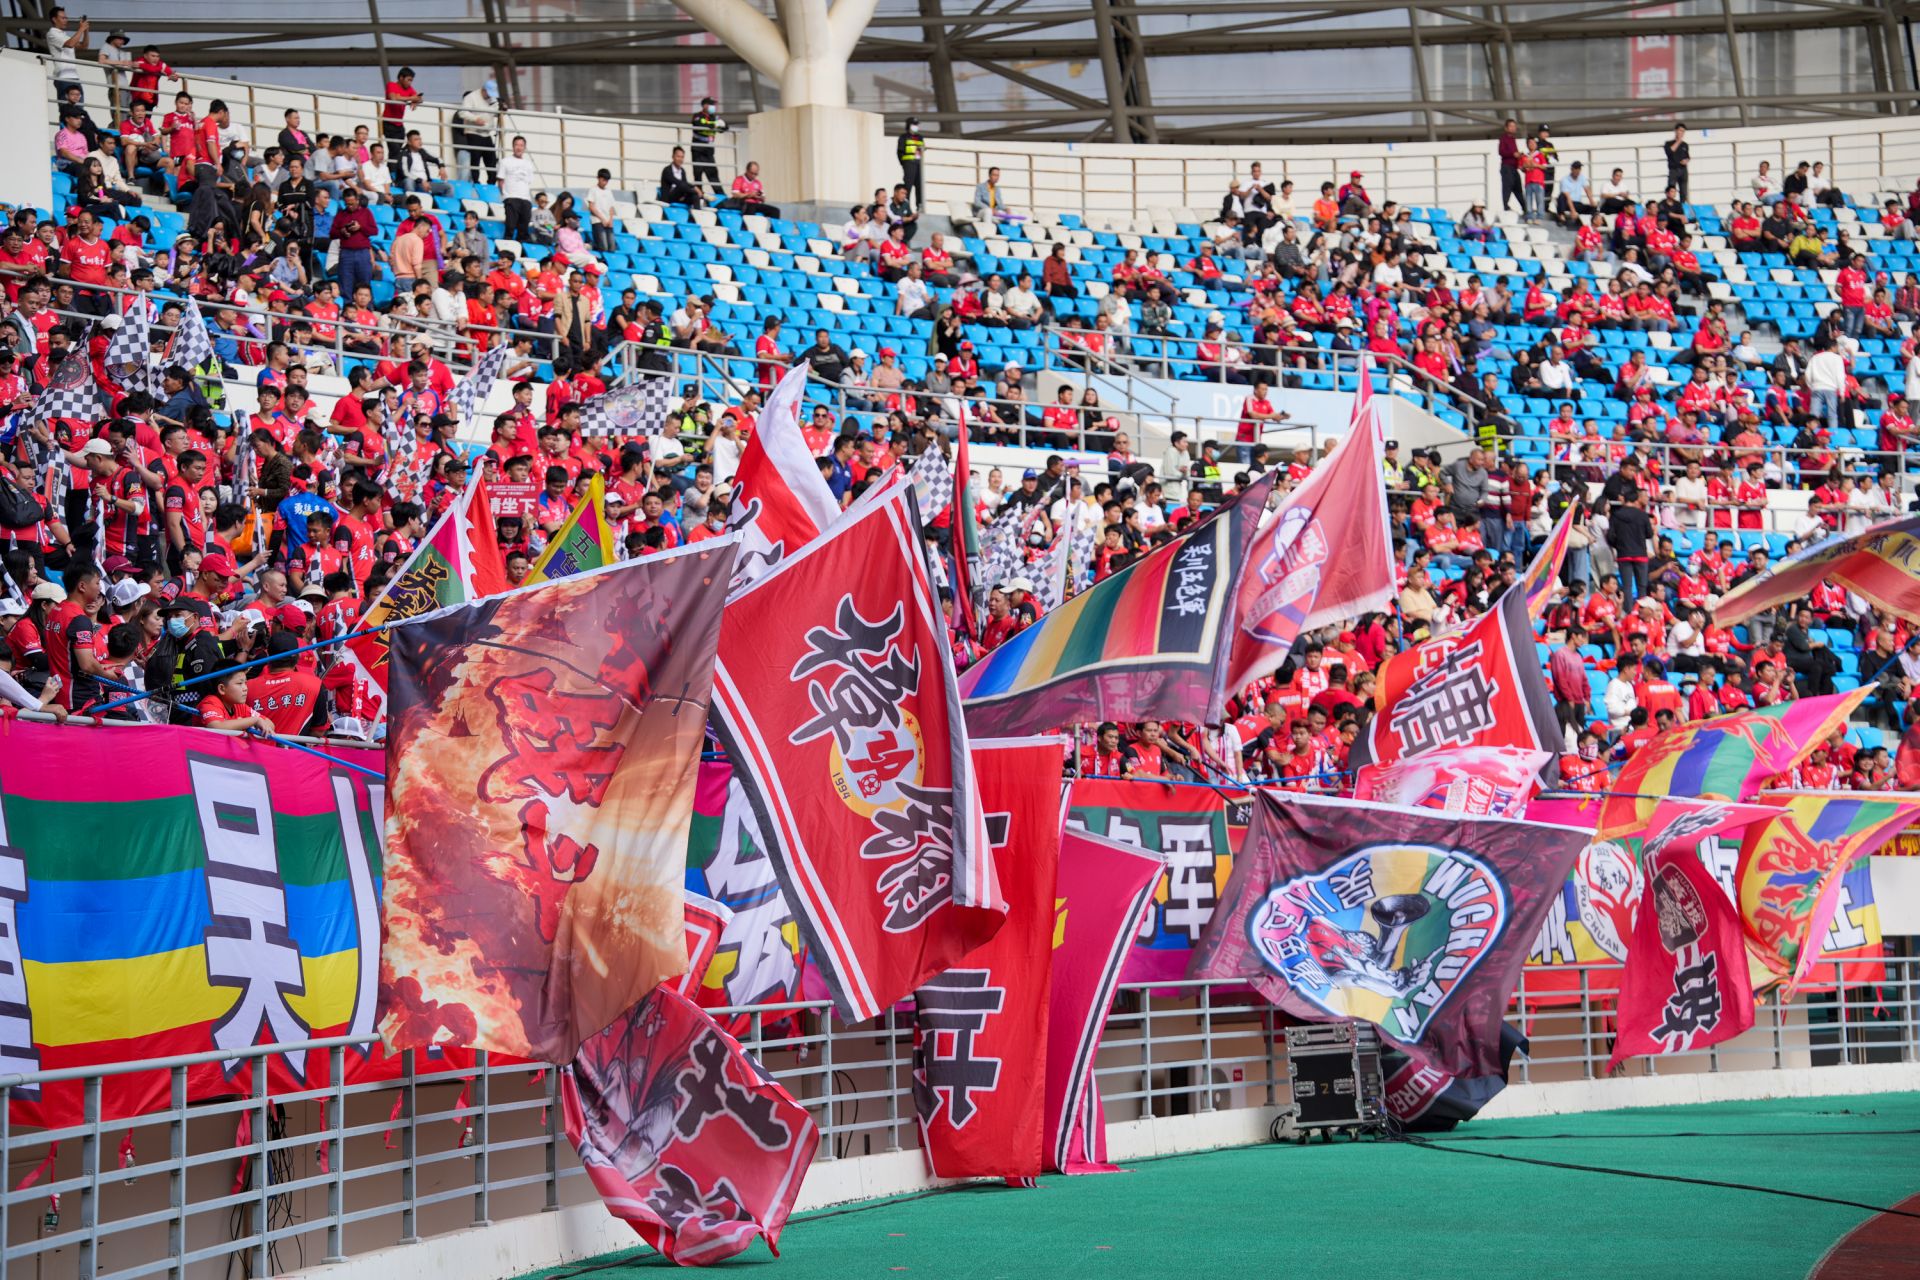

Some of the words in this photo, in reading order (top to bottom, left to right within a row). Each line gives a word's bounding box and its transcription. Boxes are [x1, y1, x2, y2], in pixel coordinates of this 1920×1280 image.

[831, 771, 850, 800] 1994
[1393, 857, 1494, 1037] WUCHUAN
[1584, 912, 1620, 954] CHUAN
